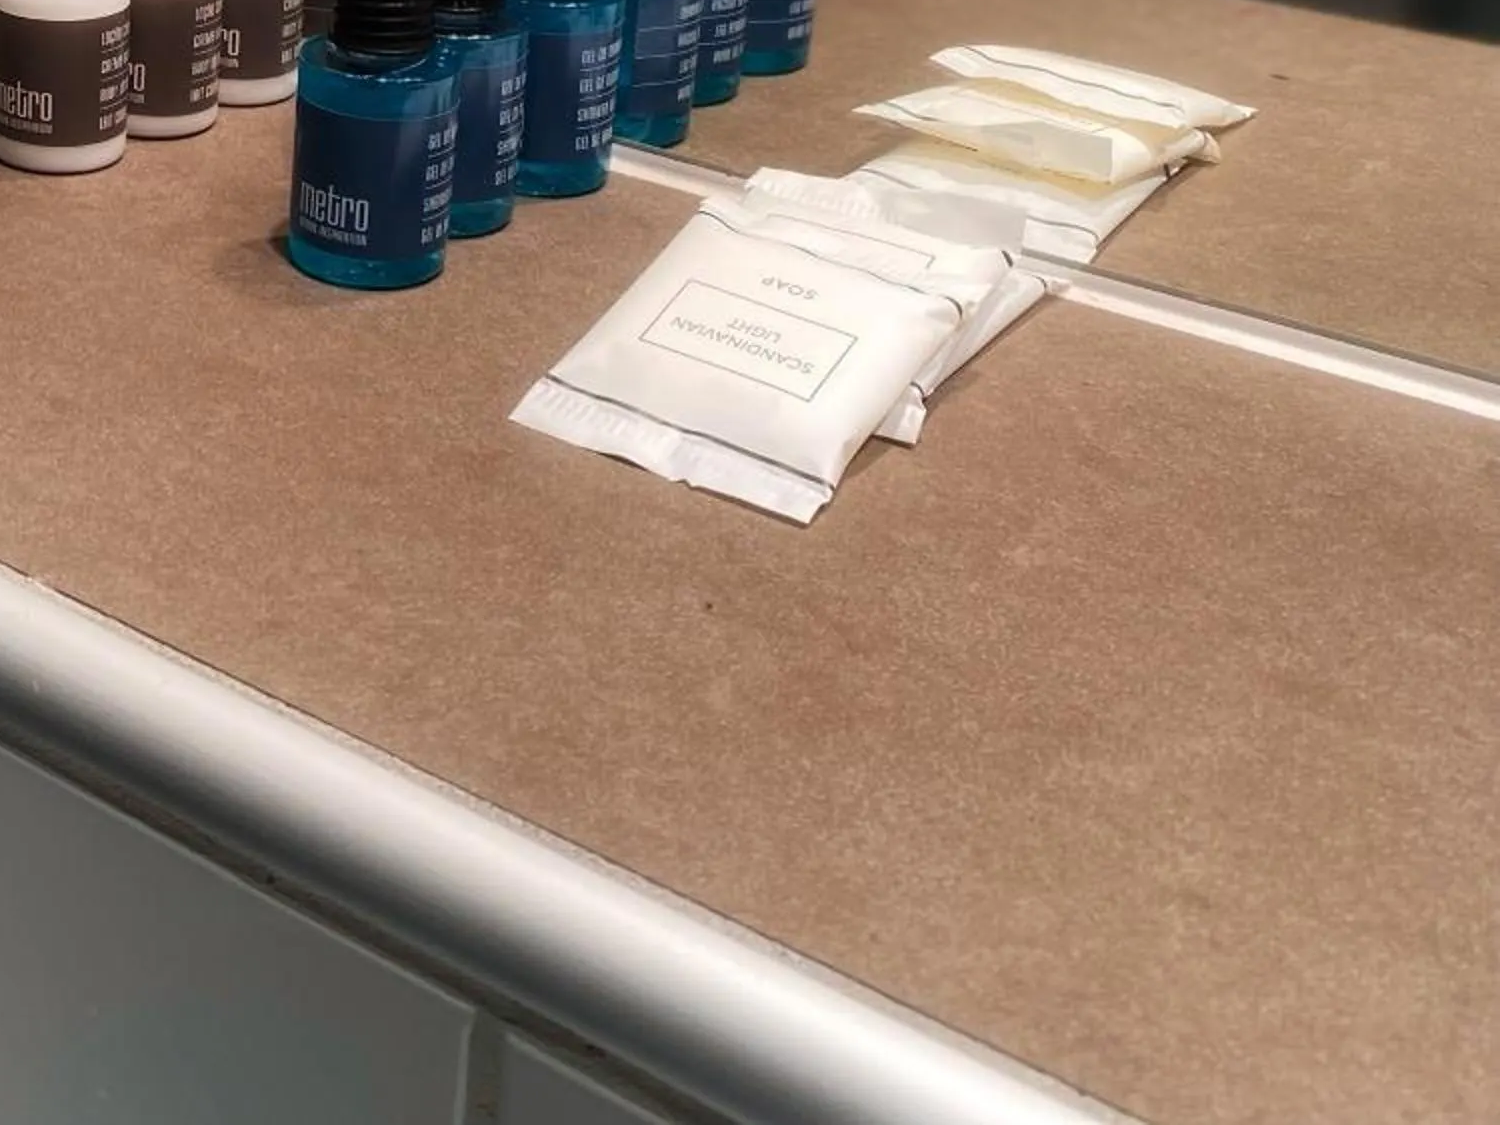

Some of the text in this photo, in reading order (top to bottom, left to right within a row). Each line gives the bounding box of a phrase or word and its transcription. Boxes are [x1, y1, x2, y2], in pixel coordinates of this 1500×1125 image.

[301, 183, 370, 232] metro
[760, 276, 819, 300] SOAP
[670, 316, 816, 374] SCANDINAVIAN
[727, 317, 782, 344] LIGHT
